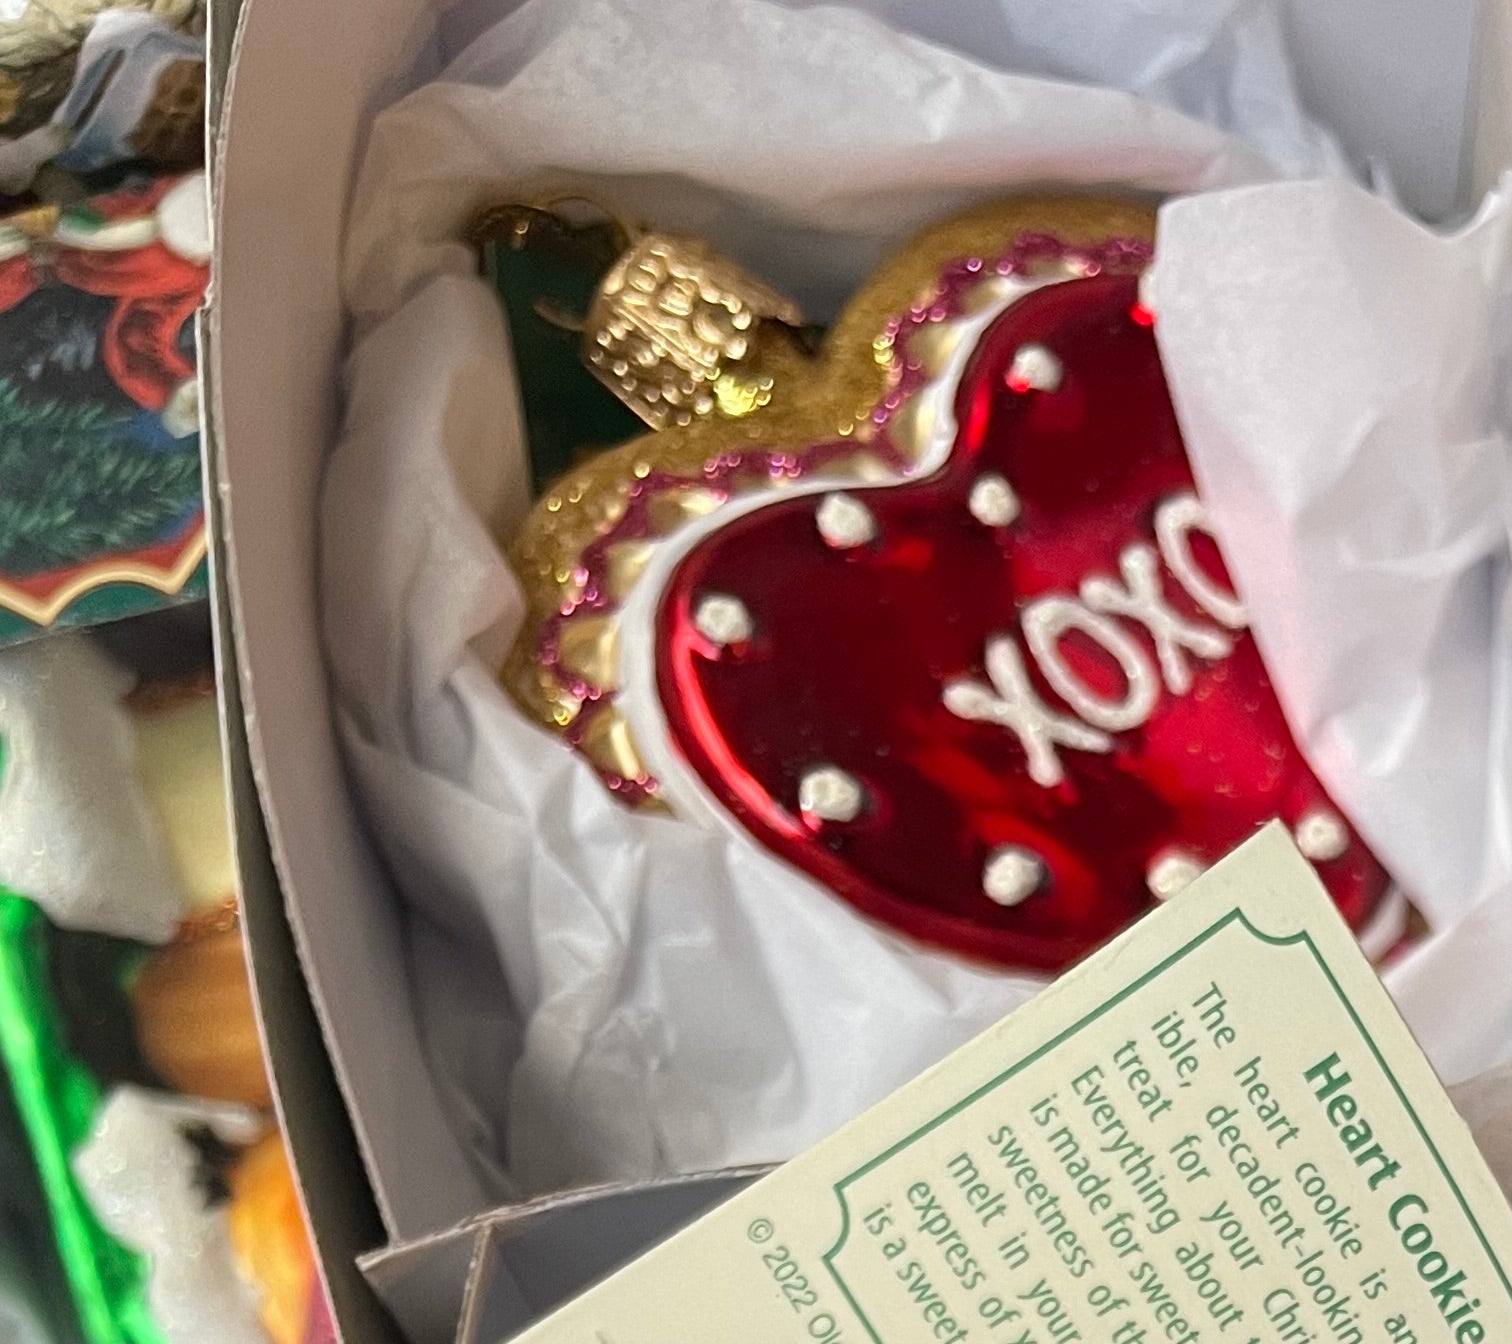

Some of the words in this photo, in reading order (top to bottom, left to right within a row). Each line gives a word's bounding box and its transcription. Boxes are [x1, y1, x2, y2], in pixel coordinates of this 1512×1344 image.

[1149, 1009, 1199, 1088] ible,
[1301, 1049, 1403, 1192] Heart
[945, 1150, 1008, 1228] melt
[996, 1230, 1030, 1271] in
[1028, 1091, 1060, 1127] is
[1046, 1124, 1113, 1216] made
[1100, 1210, 1144, 1259] for
[1069, 1063, 1182, 1235] Everything
[1174, 1240, 1245, 1333] about
[1111, 1038, 1174, 1123] treat
[1167, 1133, 1212, 1183] for
[1198, 1198, 1265, 1271] your
[1190, 979, 1236, 1050] The
[1232, 1054, 1301, 1150] heart
[1293, 1161, 1363, 1260] cookie
[1357, 1266, 1388, 1301] is
[760, 1243, 819, 1314] 2022
[861, 1201, 894, 1236] is
[880, 1236, 908, 1261] a
[905, 1180, 987, 1291] express
[977, 1295, 1023, 1329] of
[986, 1124, 1095, 1279] sweetness
[1086, 1283, 1131, 1318] of
